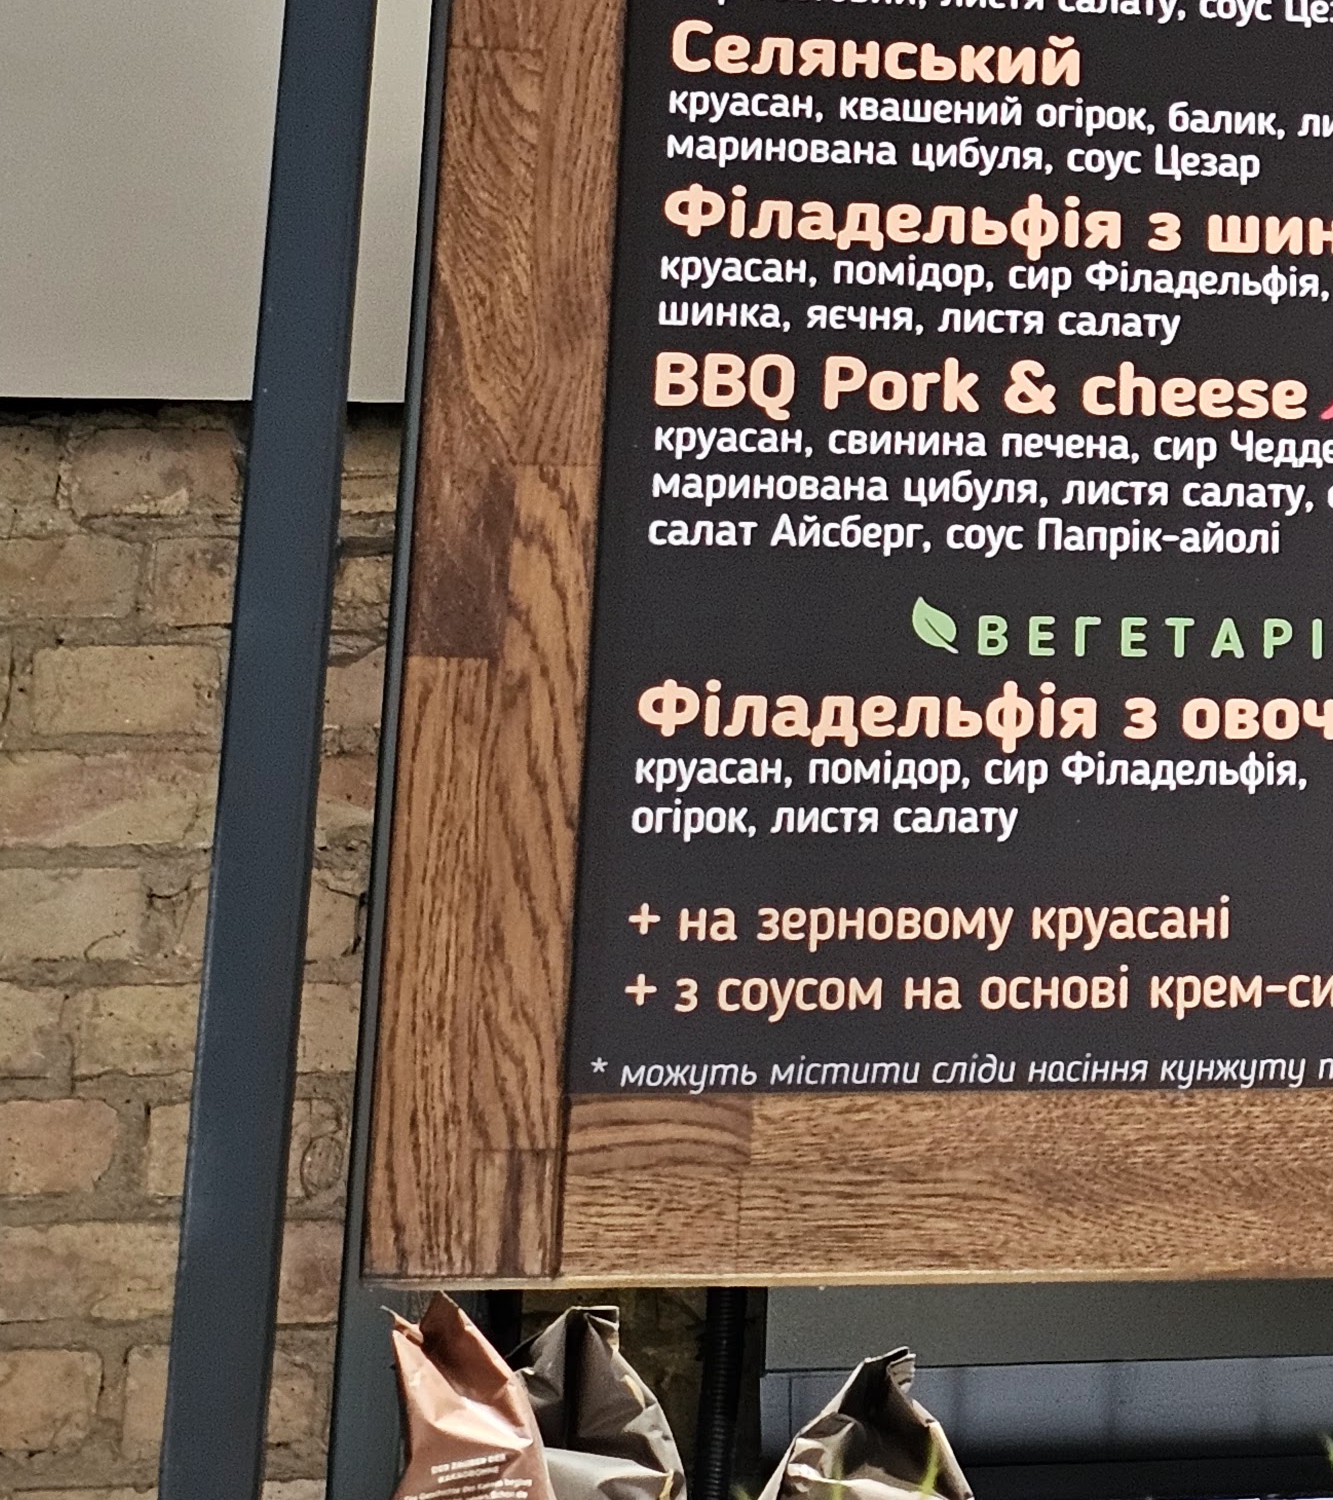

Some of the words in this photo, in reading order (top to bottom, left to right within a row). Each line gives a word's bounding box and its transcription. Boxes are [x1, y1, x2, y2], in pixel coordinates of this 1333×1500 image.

[670, 18, 1082, 88] Селянський
[662, 181, 1123, 263] Філадельфія
[1146, 210, 1183, 253] з
[656, 299, 792, 334] шинка,
[805, 303, 925, 337] яєчня,
[936, 306, 1045, 336] листя
[1056, 309, 1182, 347] салату
[652, 350, 797, 422] BBQ
[822, 354, 981, 414] Pork
[1002, 358, 1058, 416] &
[1080, 359, 1309, 421] cheese
[653, 424, 814, 462] круасан,
[827, 428, 989, 458] свинина
[1000, 431, 1141, 466] печена,
[1152, 434, 1219, 471] сир
[636, 677, 1099, 755] Філадельфія
[1121, 695, 1159, 741] з
[677, 906, 739, 943] на
[755, 905, 1016, 954] зерновому
[1030, 893, 1231, 953] круасані
[673, 976, 699, 1014] з
[716, 975, 884, 1024] соусом
[903, 975, 964, 1012] на
[978, 963, 1130, 1011] основі
[619, 1061, 760, 1096] можуть
[767, 1054, 923, 1088] містити
[929, 1053, 1018, 1087] сліди
[1025, 1052, 1151, 1086] насіння
[1157, 1056, 1307, 1091] кунжуту
